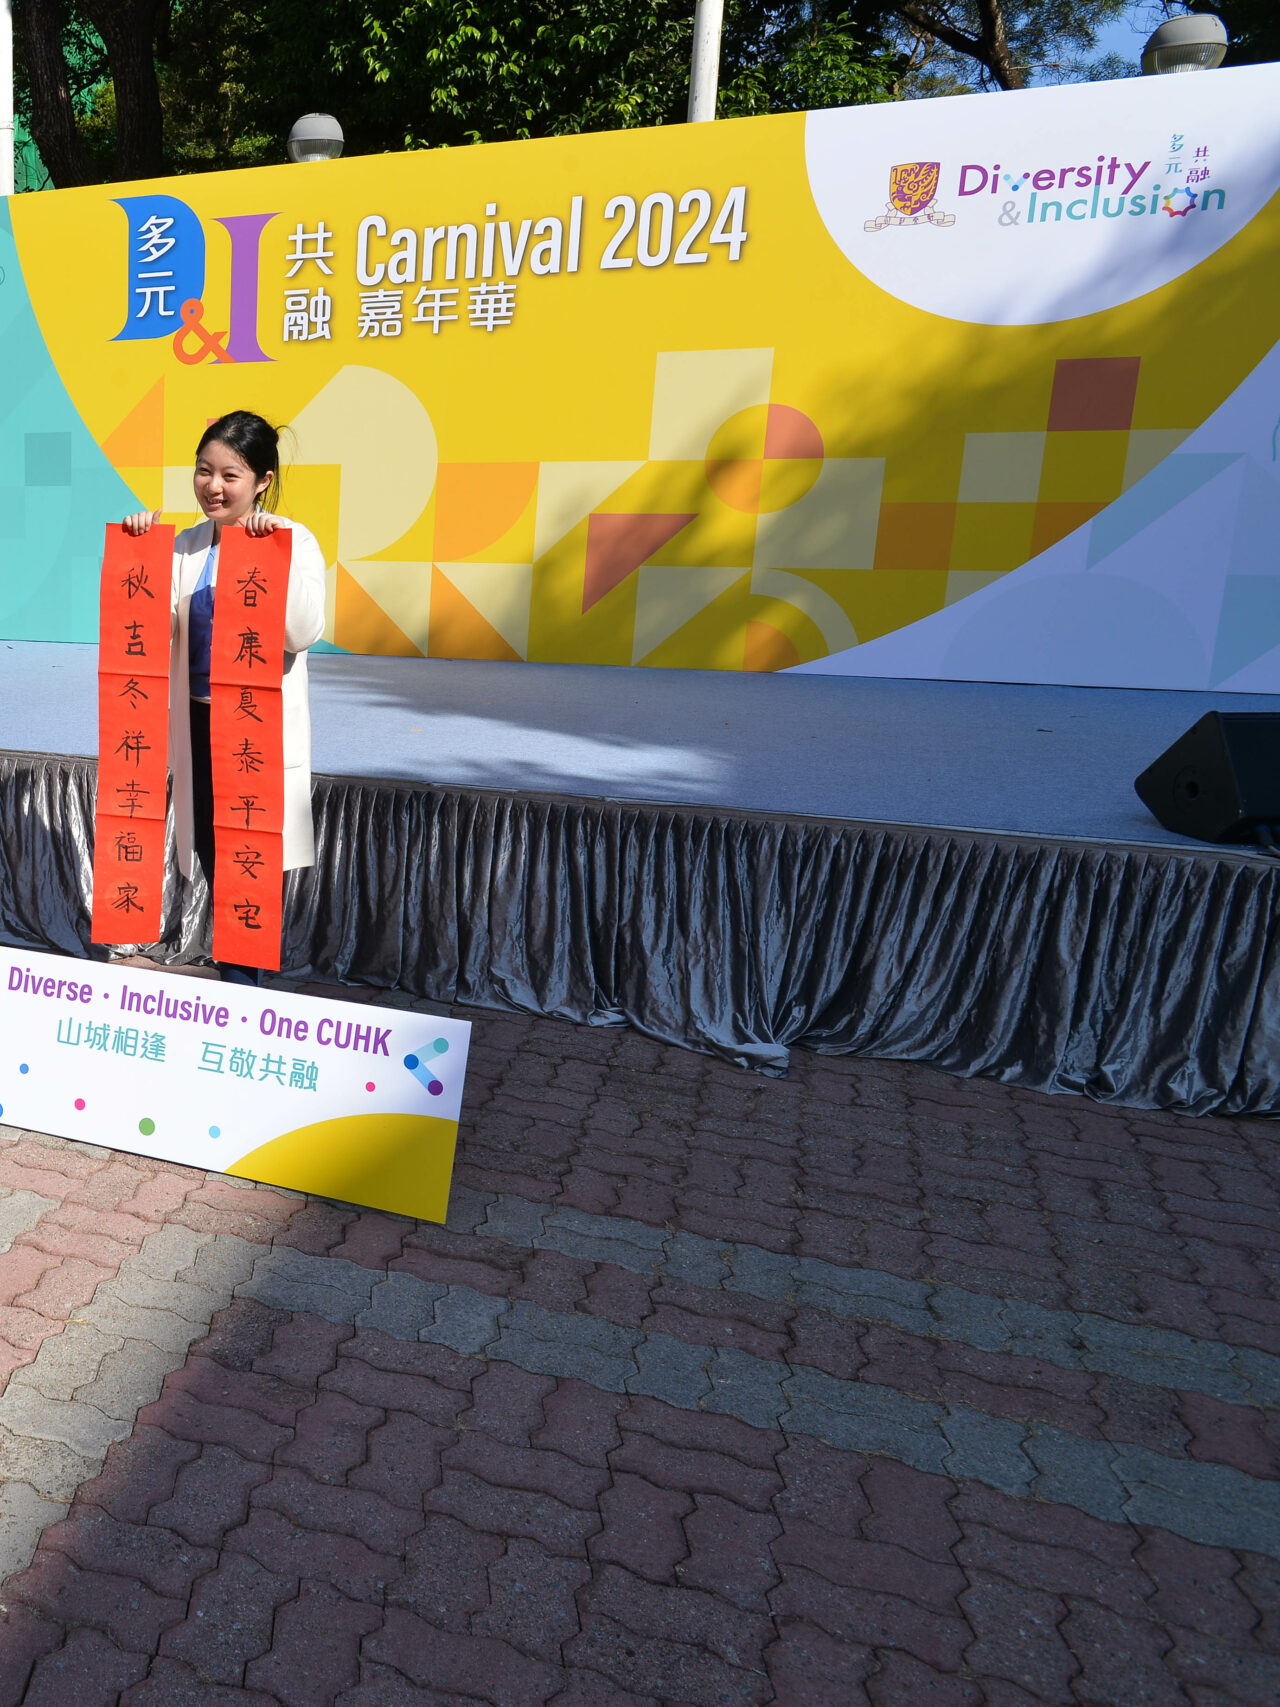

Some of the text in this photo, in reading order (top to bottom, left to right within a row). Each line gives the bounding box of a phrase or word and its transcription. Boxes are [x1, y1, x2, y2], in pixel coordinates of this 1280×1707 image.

[958, 155, 1152, 197] Diversity
[1163, 133, 1186, 175] 多元
[1186, 145, 1212, 185] 共融
[135, 214, 177, 319] 多元
[356, 185, 748, 286] Carnival 2024
[282, 221, 334, 342] 共融
[357, 280, 517, 338] 嘉年華
[111, 565, 156, 914] 秋吉冬祥幸福家
[7, 965, 94, 1005] Diverse
[120, 984, 230, 1028] Inclusive
[259, 1007, 309, 1043] One
[316, 1017, 393, 1058] CUHK
[198, 1040, 319, 1093] 互敬共融
